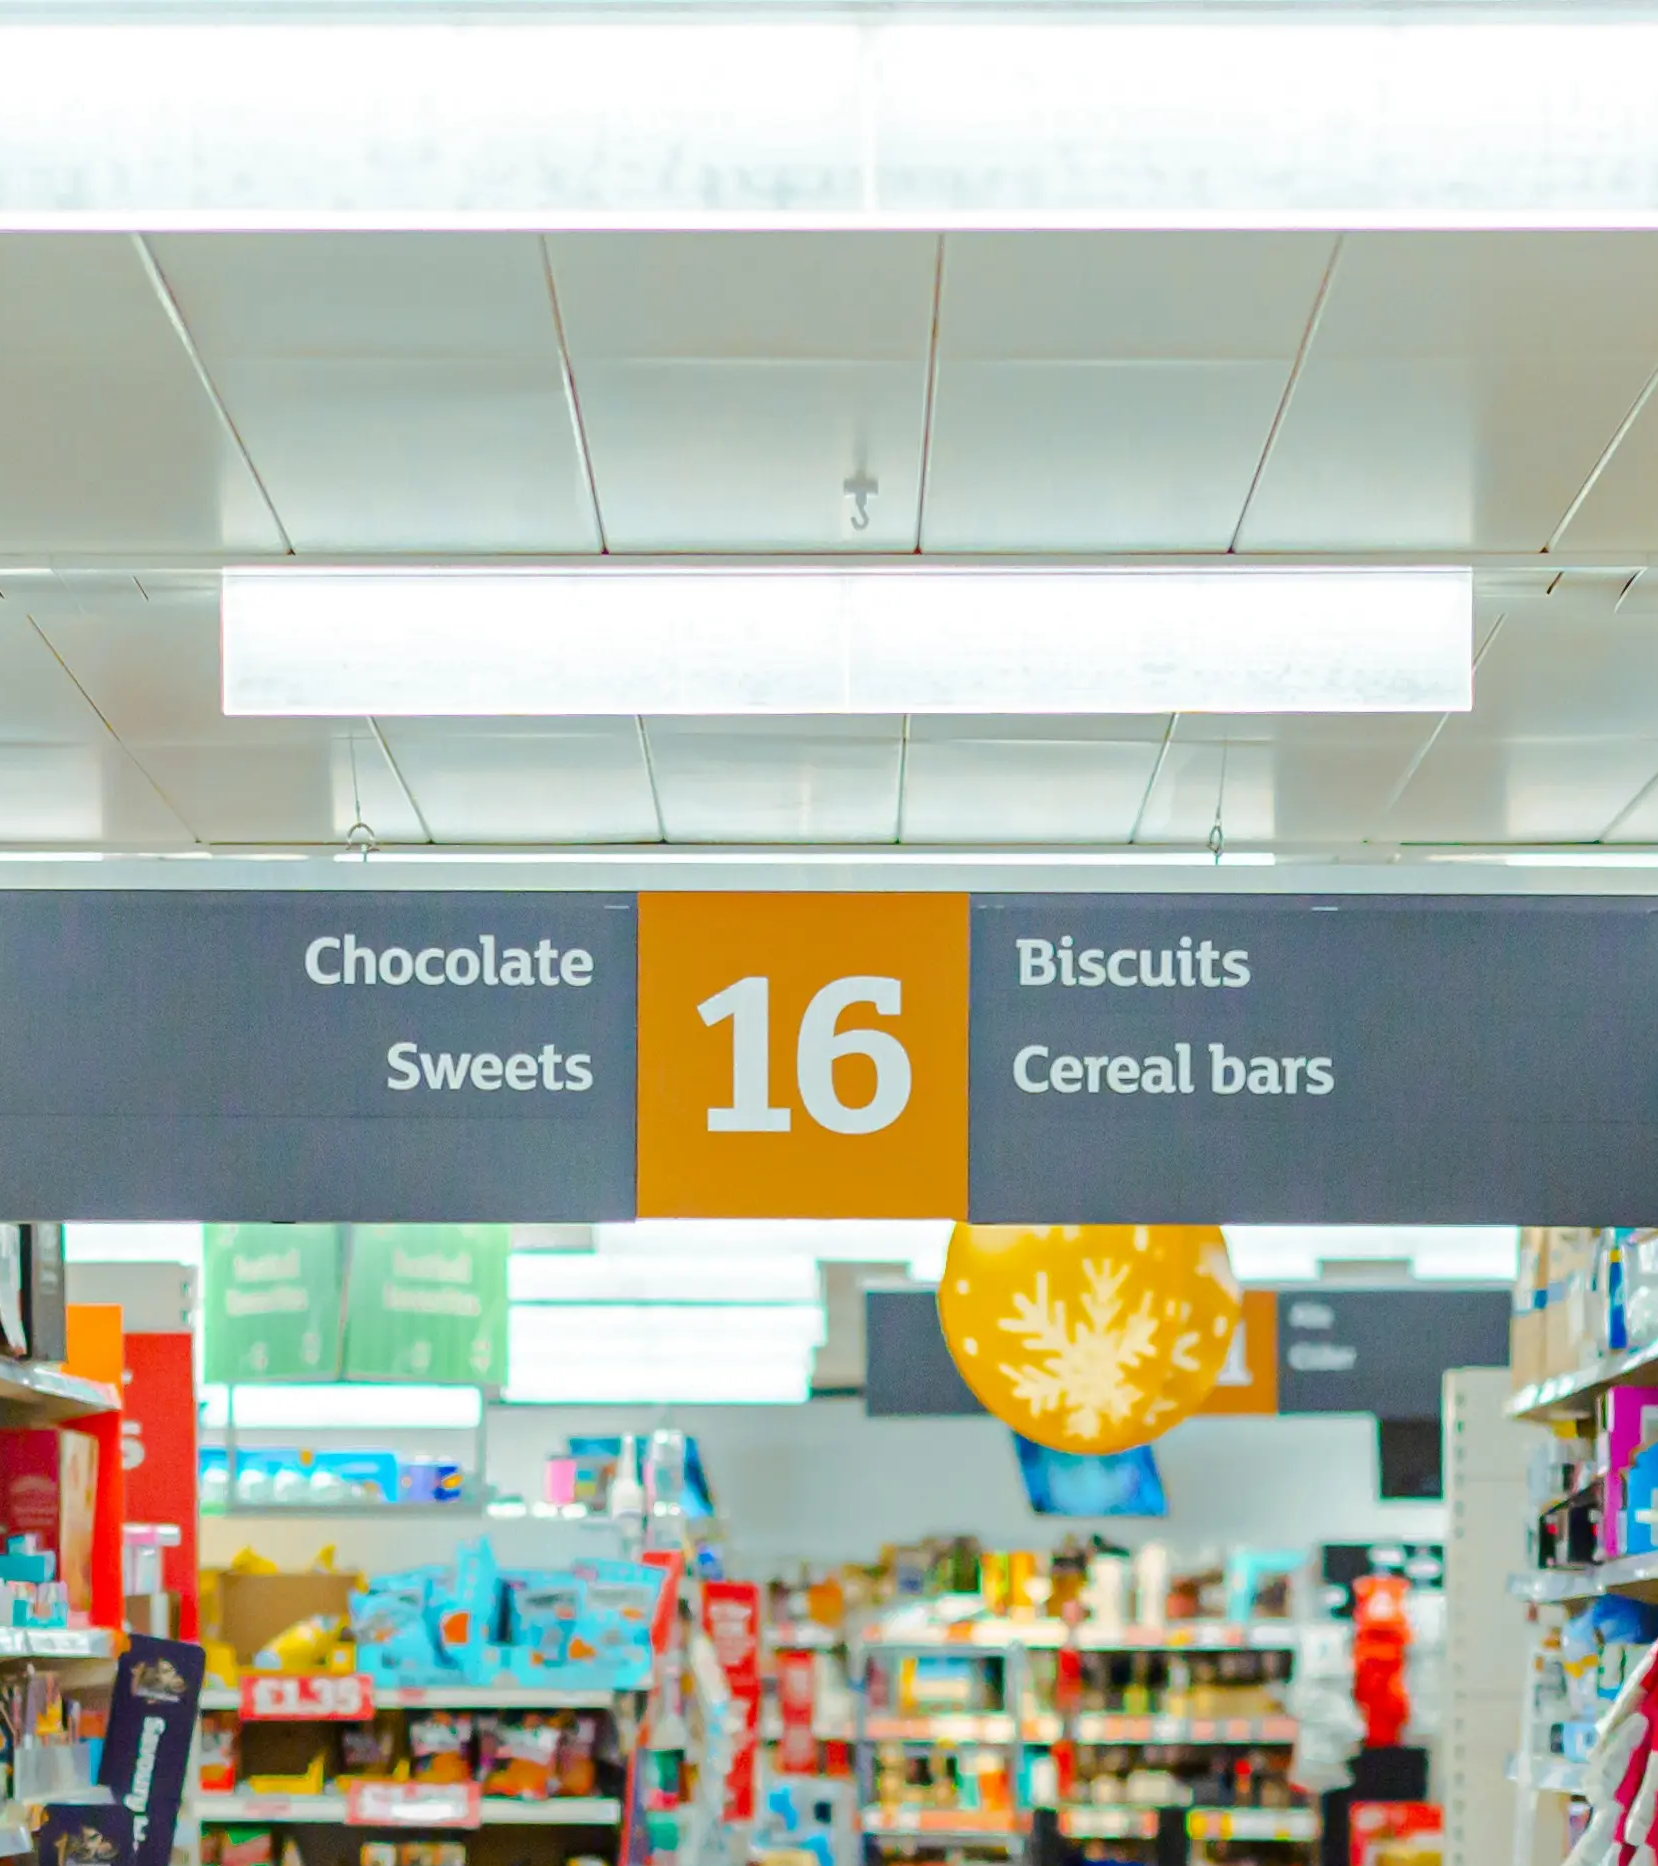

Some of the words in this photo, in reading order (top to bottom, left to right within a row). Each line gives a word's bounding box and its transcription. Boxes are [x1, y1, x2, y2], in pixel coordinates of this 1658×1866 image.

[304, 934, 594, 987] Chocolate
[1015, 936, 1251, 988] Biscuits
[387, 1042, 593, 1091] Sweets
[697, 976, 912, 1135] 16
[1014, 1043, 1195, 1094] Cereal
[1209, 1043, 1335, 1095] bars
